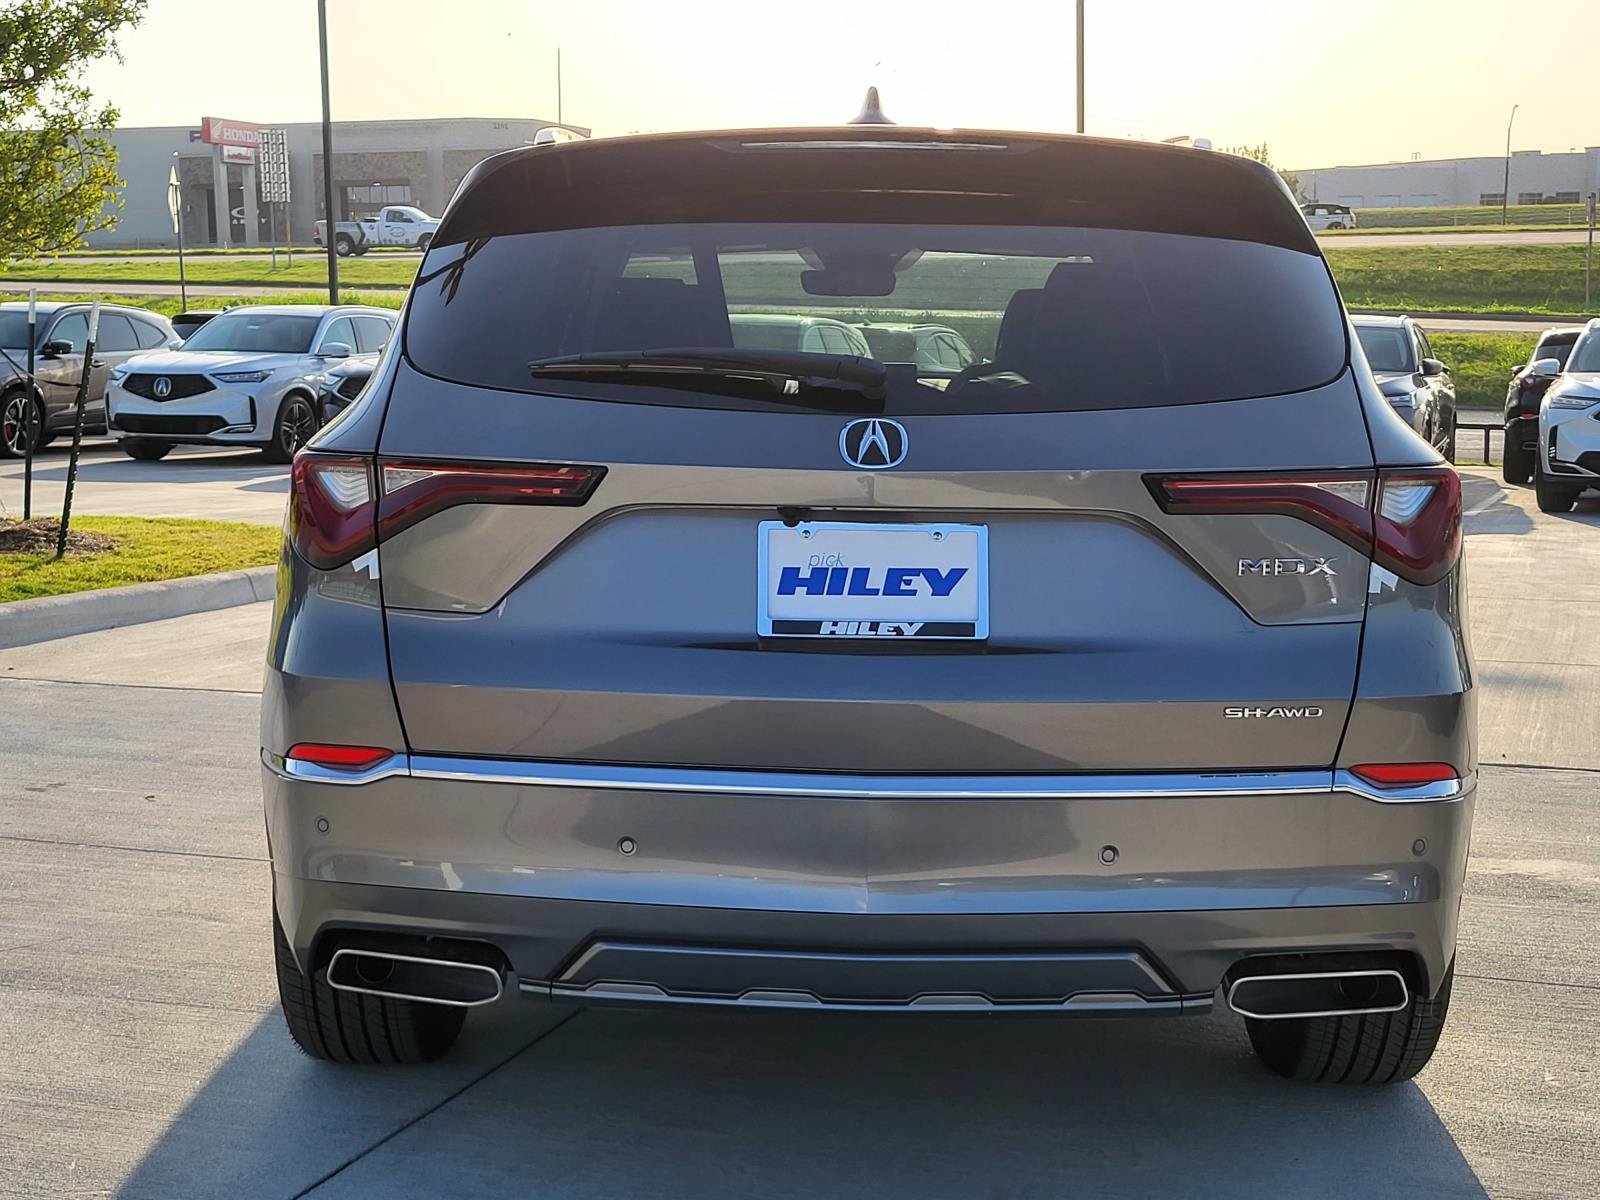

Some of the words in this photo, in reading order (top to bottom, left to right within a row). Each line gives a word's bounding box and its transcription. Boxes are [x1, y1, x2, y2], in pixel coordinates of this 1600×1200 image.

[223, 127, 262, 143] HONDA
[808, 552, 847, 569] pick
[1238, 557, 1338, 577] MDX
[777, 566, 969, 597] HILEY
[819, 621, 925, 636] HILEY
